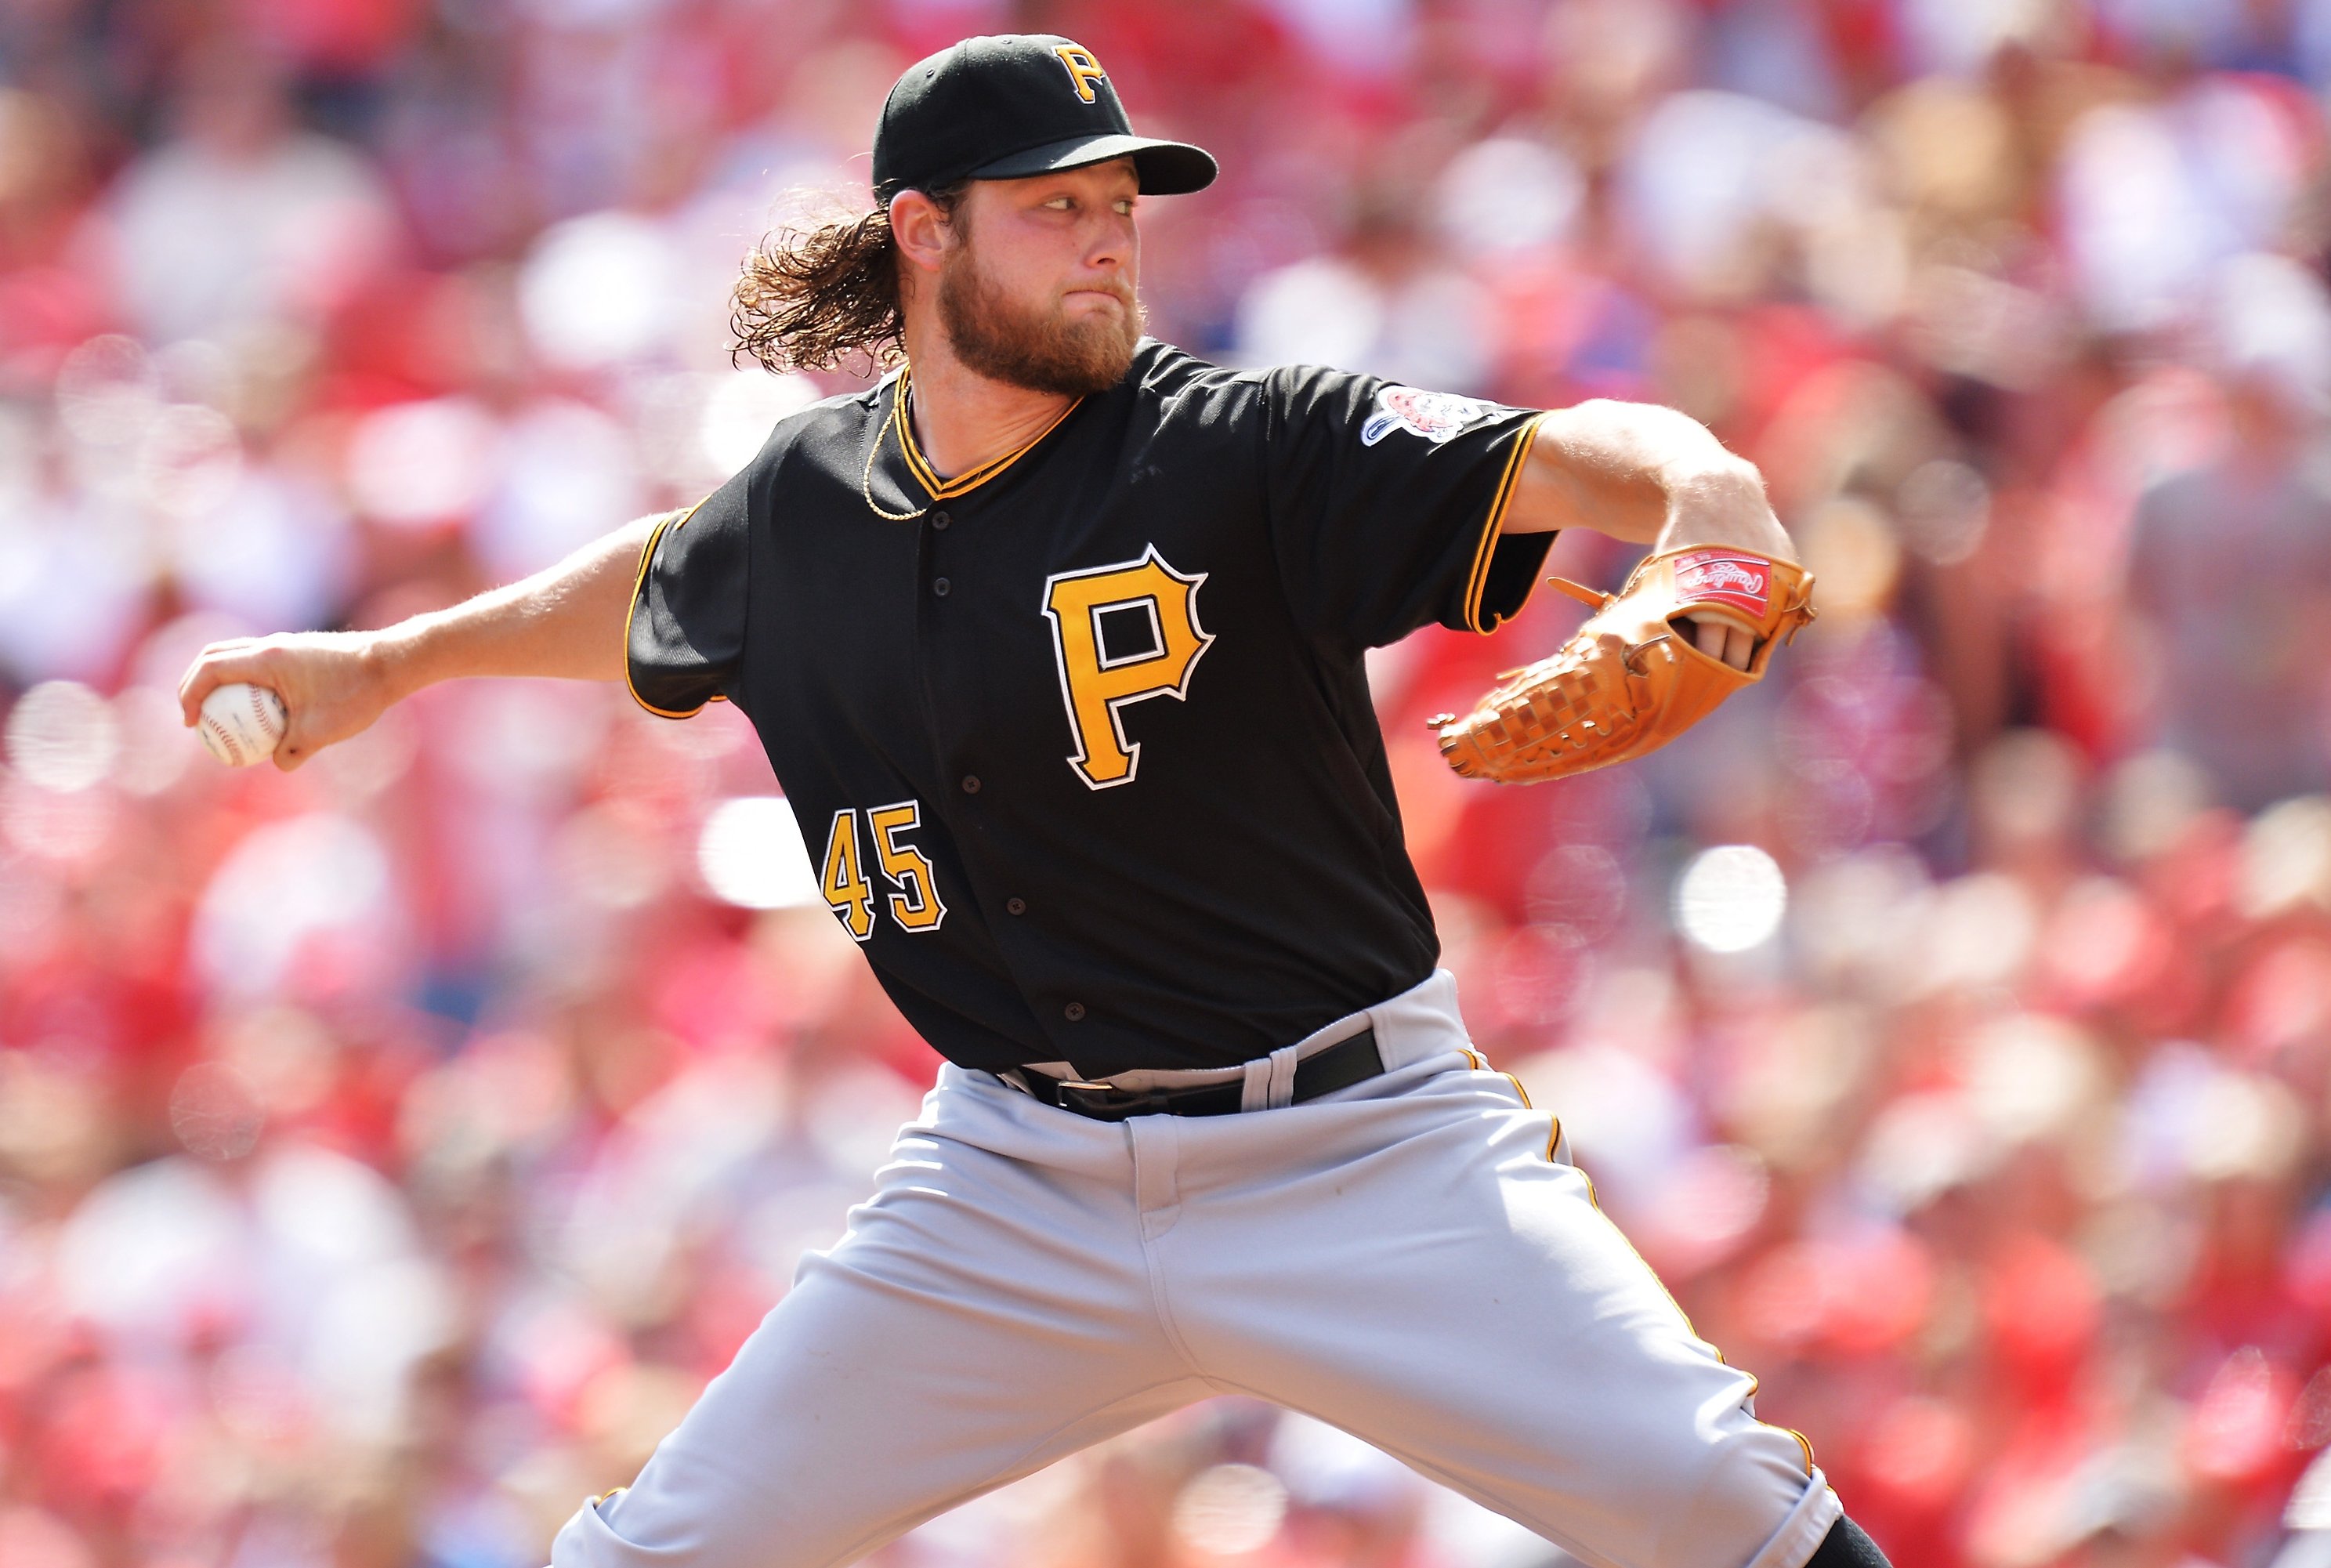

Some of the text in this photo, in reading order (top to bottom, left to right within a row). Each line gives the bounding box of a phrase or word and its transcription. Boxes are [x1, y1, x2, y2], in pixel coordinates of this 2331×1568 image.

[1051, 44, 1106, 104] P
[1685, 562, 1764, 594] Rawlings
[1041, 542, 1217, 791] P
[820, 799, 948, 942] 45
